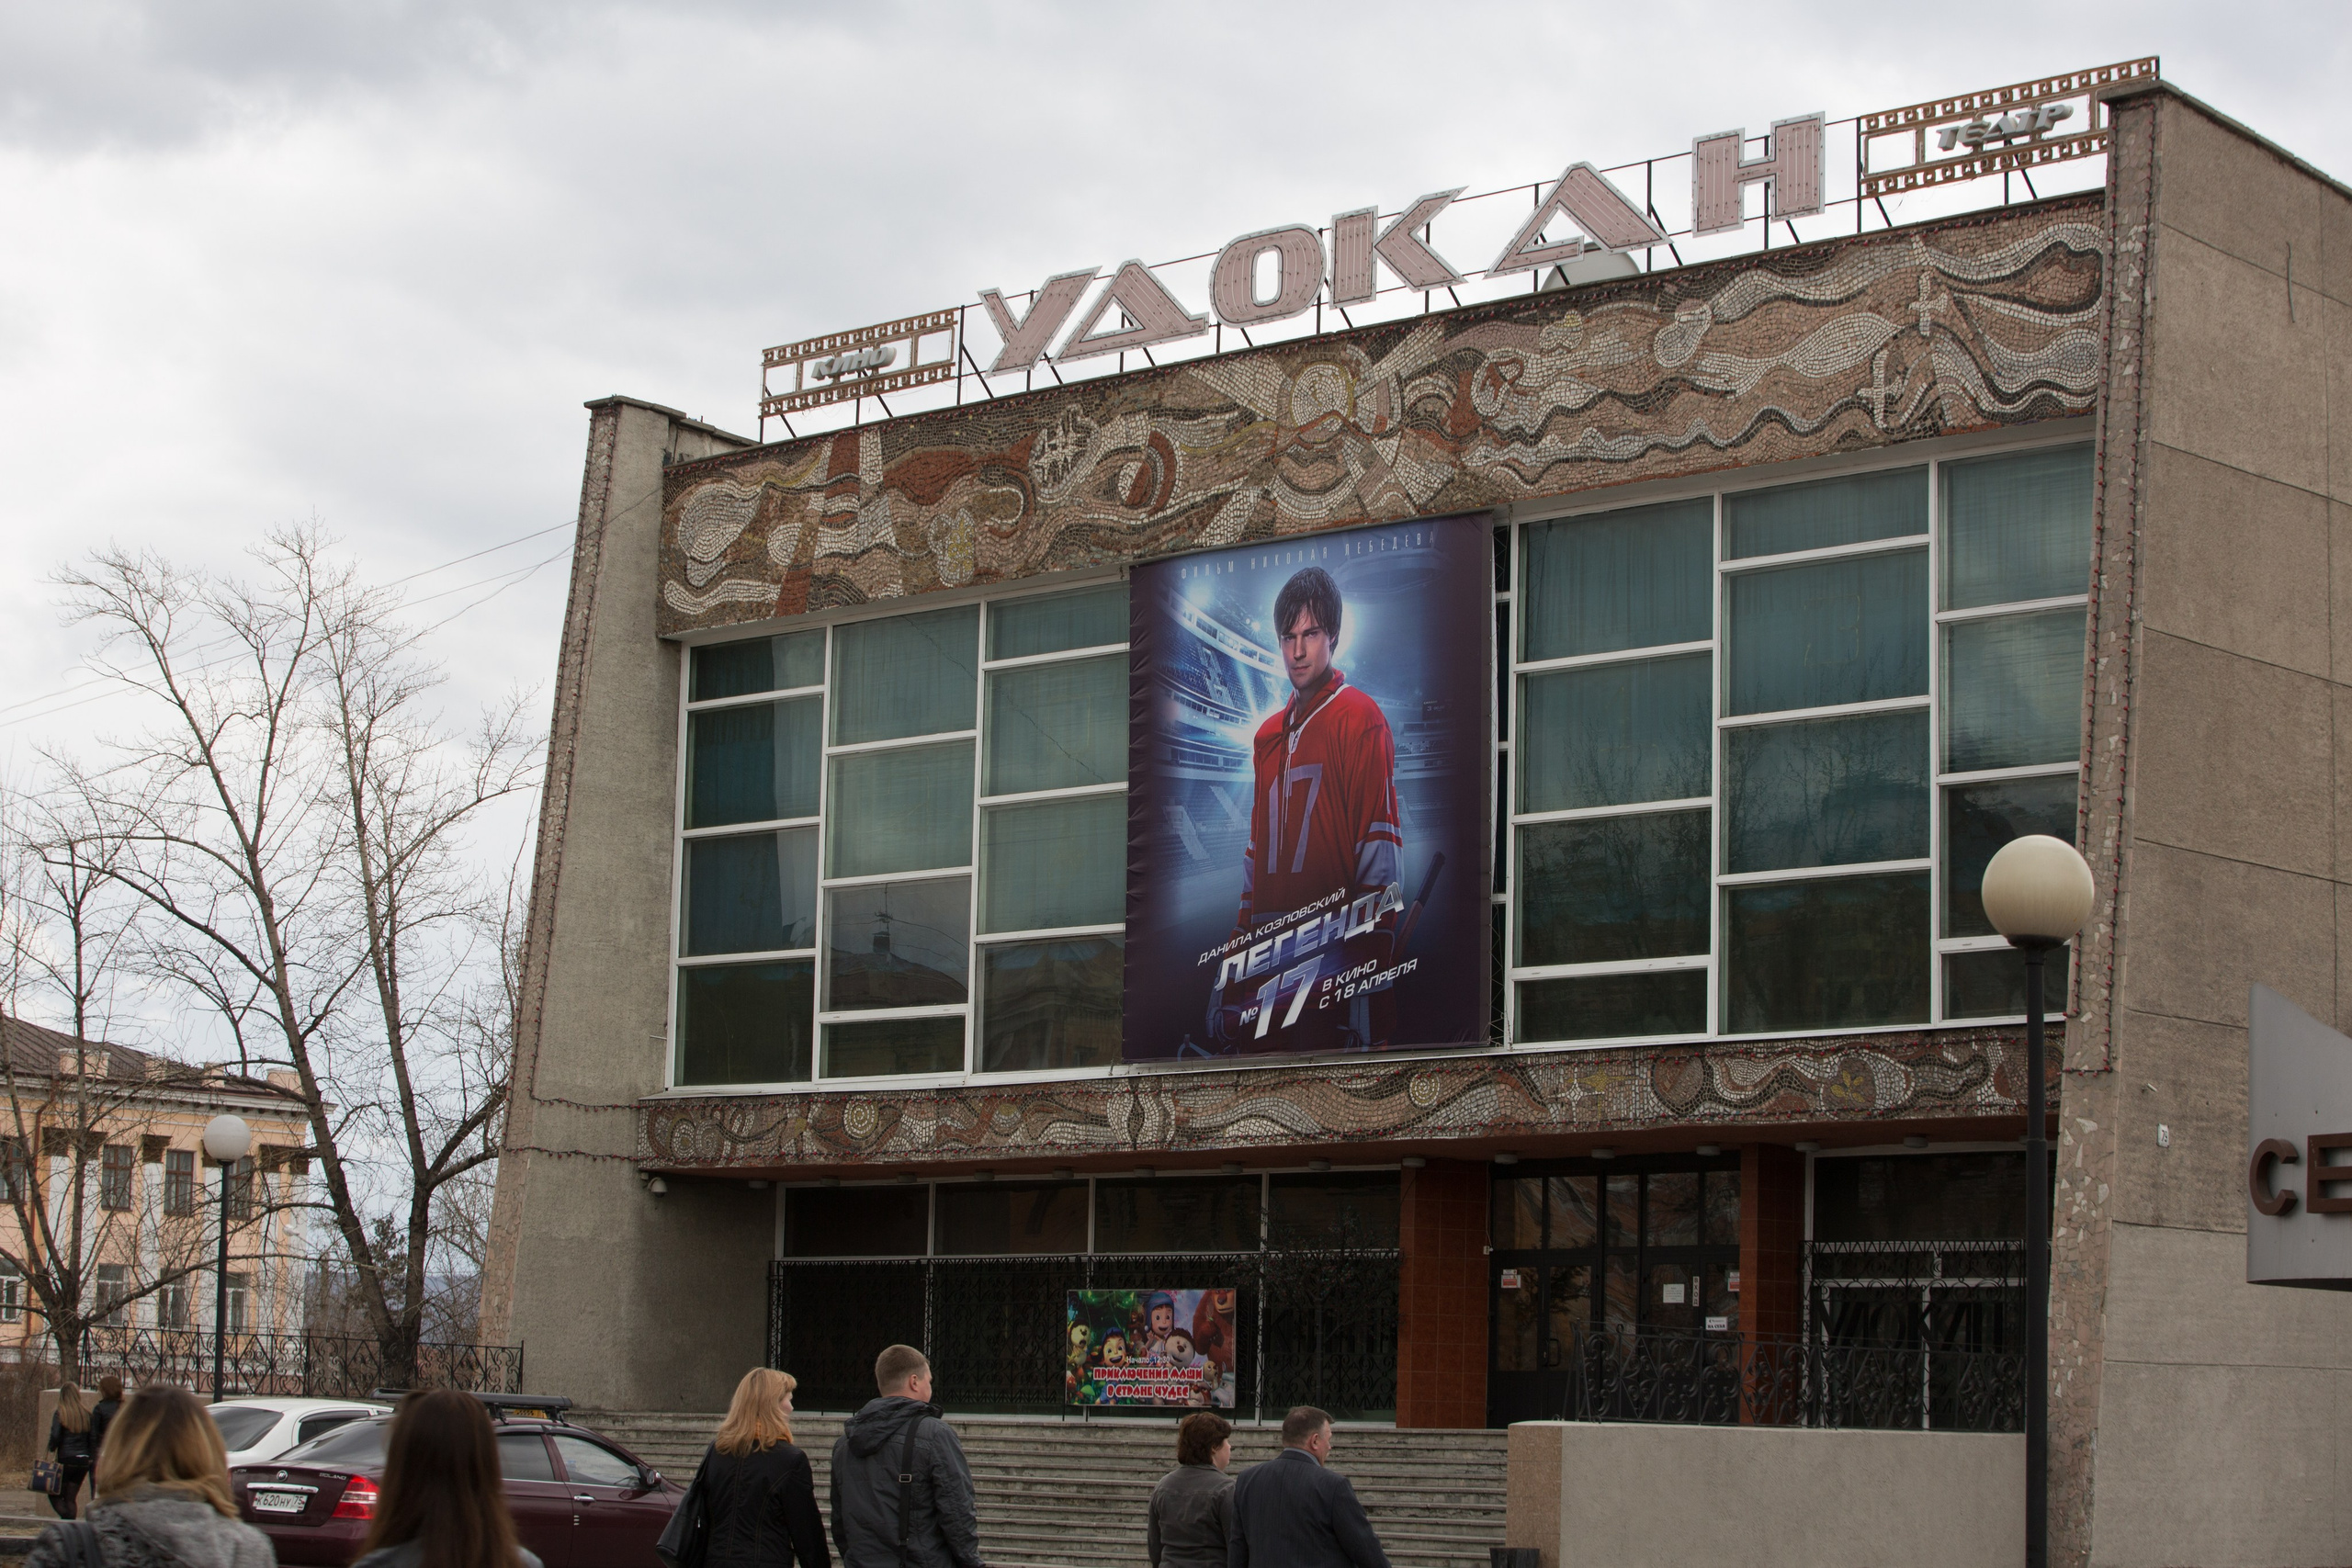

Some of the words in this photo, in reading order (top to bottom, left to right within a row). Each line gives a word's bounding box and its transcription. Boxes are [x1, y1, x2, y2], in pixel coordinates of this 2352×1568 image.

[1936, 104, 2074, 152] ТЕАТР
[977, 110, 1826, 378] УДОКАН
[810, 346, 897, 381] КИНО
[1181, 560, 1234, 580] ФИЛЬМ
[1250, 547, 1328, 570] НИКОЛАЯ
[1345, 531, 1434, 557] ЛЕБЕДЕВА
[1268, 763, 1323, 874] 17
[1197, 932, 1252, 966] ДАНИЛА
[1255, 886, 1346, 937] КОЗЛОВСКИЙ
[1214, 881, 1405, 991] ЛЕГЕНДА
[1254, 954, 1324, 1040] 17
[1318, 995, 1329, 1010] С
[1334, 983, 1355, 1002] 18
[1357, 958, 1419, 993] АПРЕЛЯ
[1322, 977, 1333, 992] В
[1335, 959, 1377, 987] КИНО
[1093, 1366, 1169, 1382] ПРИКЛЮЧЕНИЯ
[1170, 1366, 1204, 1382] МАШИ
[1153, 1356, 1170, 1364] 12:30
[1107, 1384, 1114, 1397] В
[1115, 1384, 1153, 1397] СТРАНЕ
[1154, 1384, 1189, 1400] ЧУДЕС
[293, 1495, 303, 1506] 75
